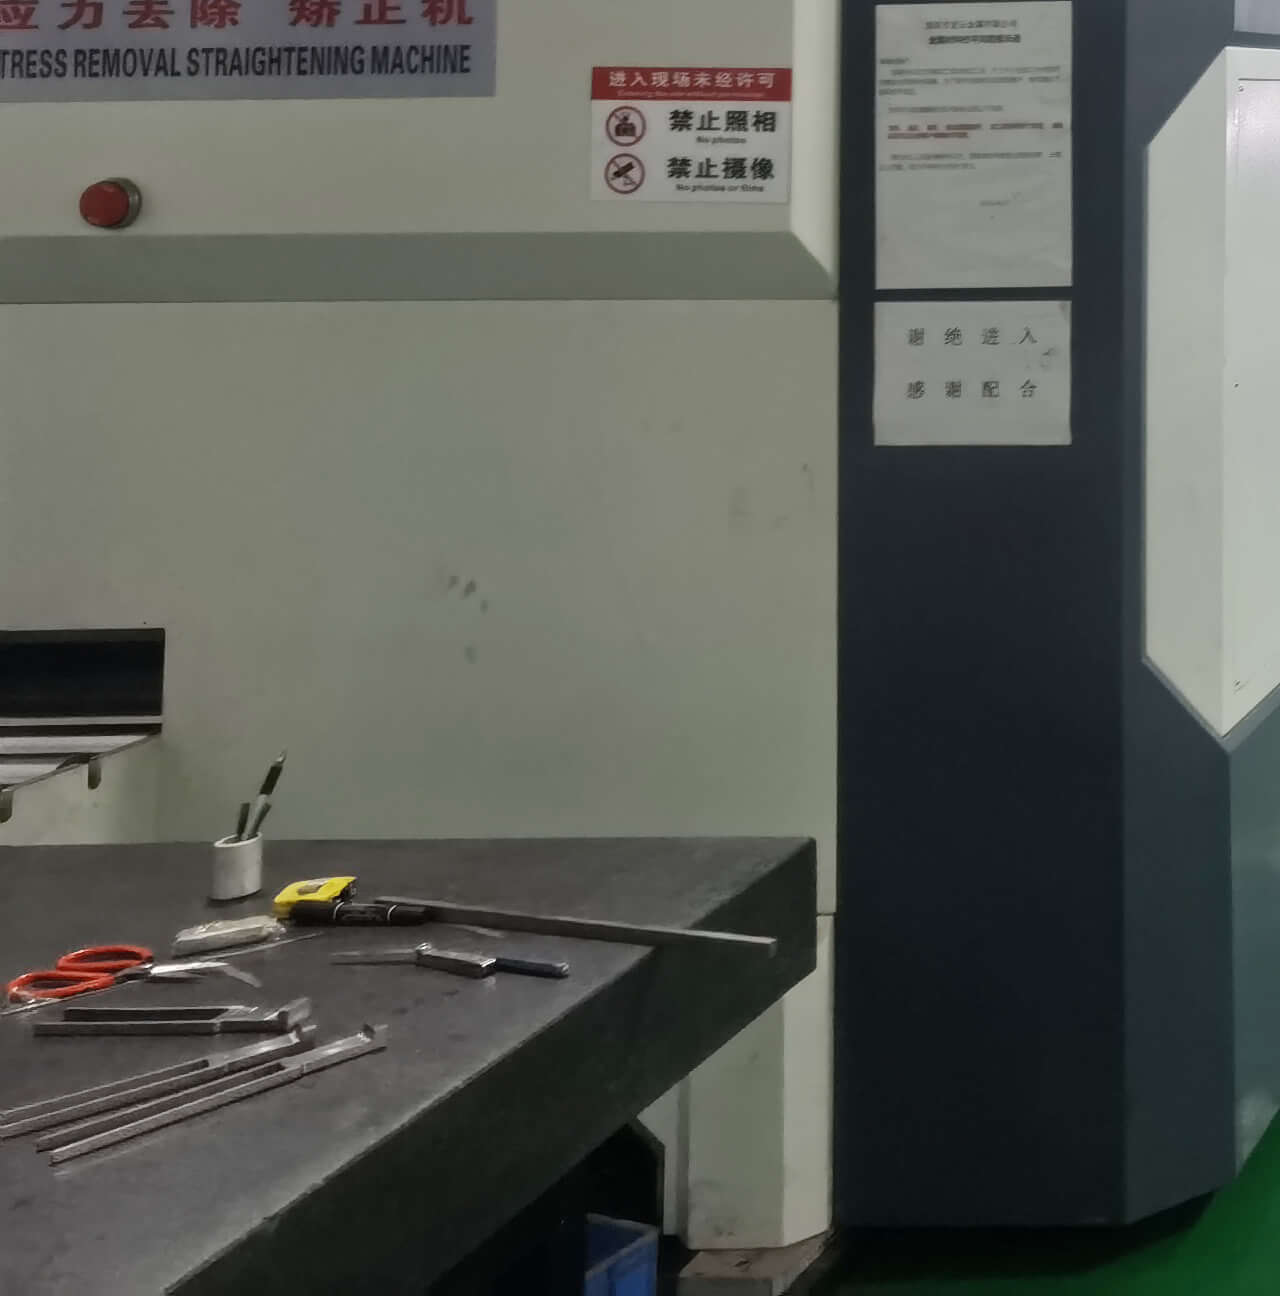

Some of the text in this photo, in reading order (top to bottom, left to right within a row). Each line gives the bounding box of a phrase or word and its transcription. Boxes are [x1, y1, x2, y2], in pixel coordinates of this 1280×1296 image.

[74, 48, 181, 78] REMOVAL
[187, 45, 365, 77] STRAIGHTENING
[370, 44, 472, 74] MACHINE
[608, 71, 776, 89] 进入现场未经许可
[668, 109, 777, 133] 禁止照相
[667, 157, 776, 181] 禁止摄像
